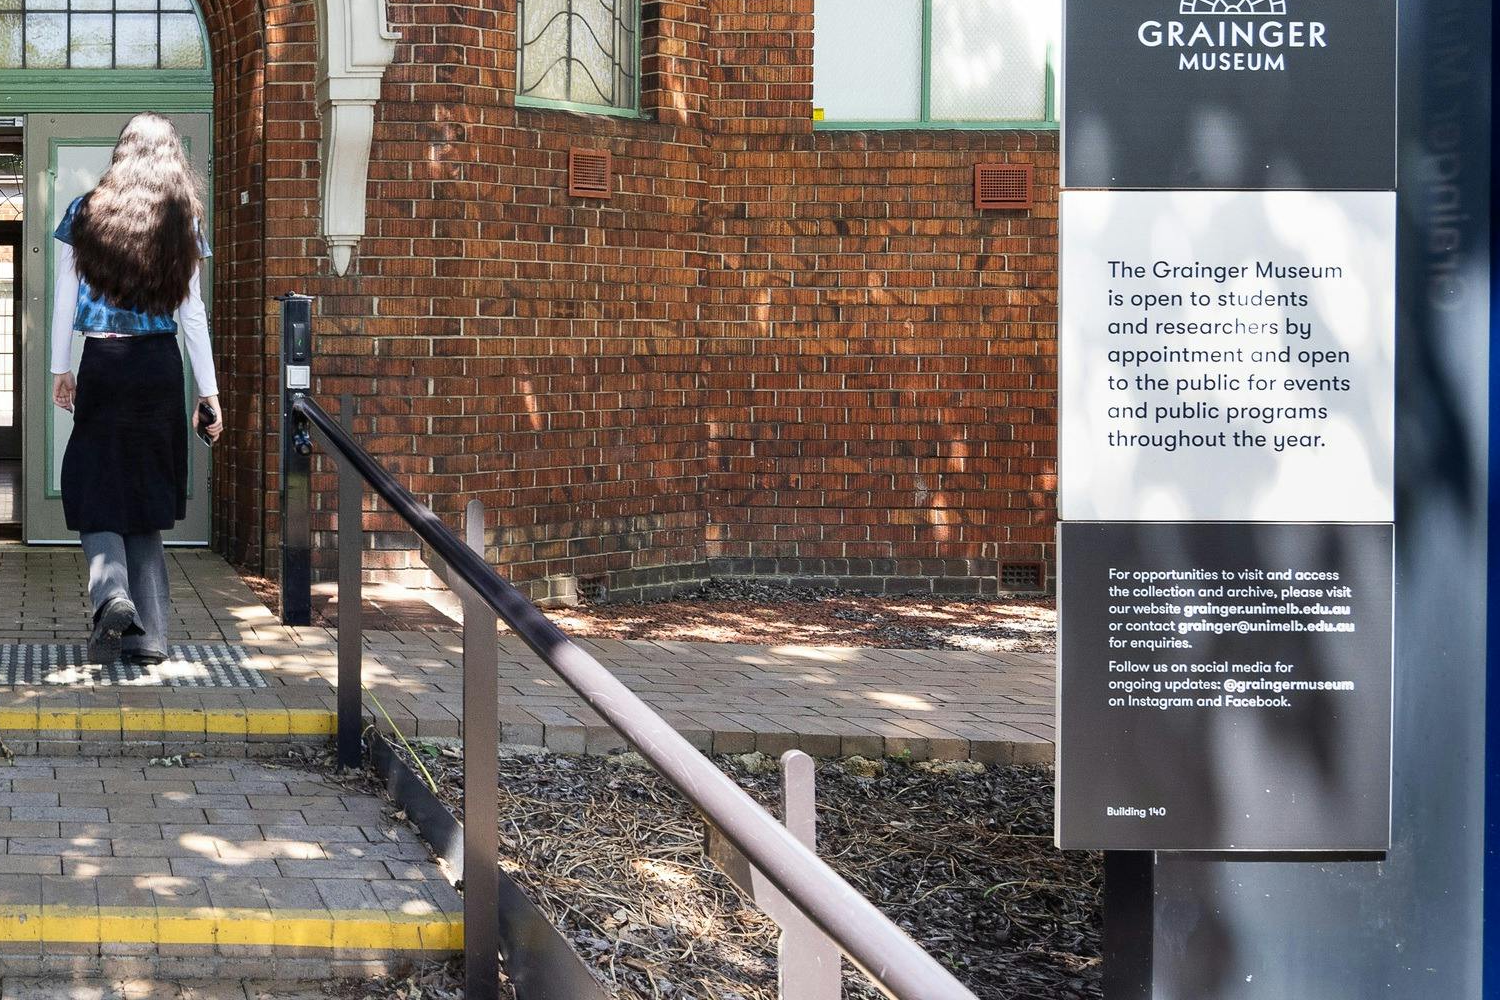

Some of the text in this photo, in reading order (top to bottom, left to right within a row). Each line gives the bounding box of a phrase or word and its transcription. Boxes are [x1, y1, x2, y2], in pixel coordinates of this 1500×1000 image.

[1138, 21, 1327, 47] GRAINGER
[1178, 52, 1285, 71] MUSEUM
[1108, 261, 1342, 283] The Grainger Museum
[1109, 290, 1308, 310] is open to students
[1108, 318, 1311, 339] and researchers by
[1108, 346, 1349, 367] appointment and open
[1108, 374, 1350, 395] to the public for events
[1108, 402, 1327, 423] and public programs
[1108, 430, 1325, 451] throughout the year.
[1109, 568, 1339, 583] For opportunities to visit and access
[1109, 586, 1352, 600] the collection and archive, please visit
[1109, 602, 1350, 617] our website grainger.unimelb.edu.au
[1109, 619, 1355, 634] or contact grainger@unimelb.edu.au
[1109, 637, 1192, 651] for enquiries.
[1109, 661, 1293, 672] Follow us on social media for
[1109, 678, 1354, 692] ongoing updates: @graingermuseum
[1109, 695, 1291, 710] on Instagram and Facebook.
[1107, 807, 1166, 818] Building 140
